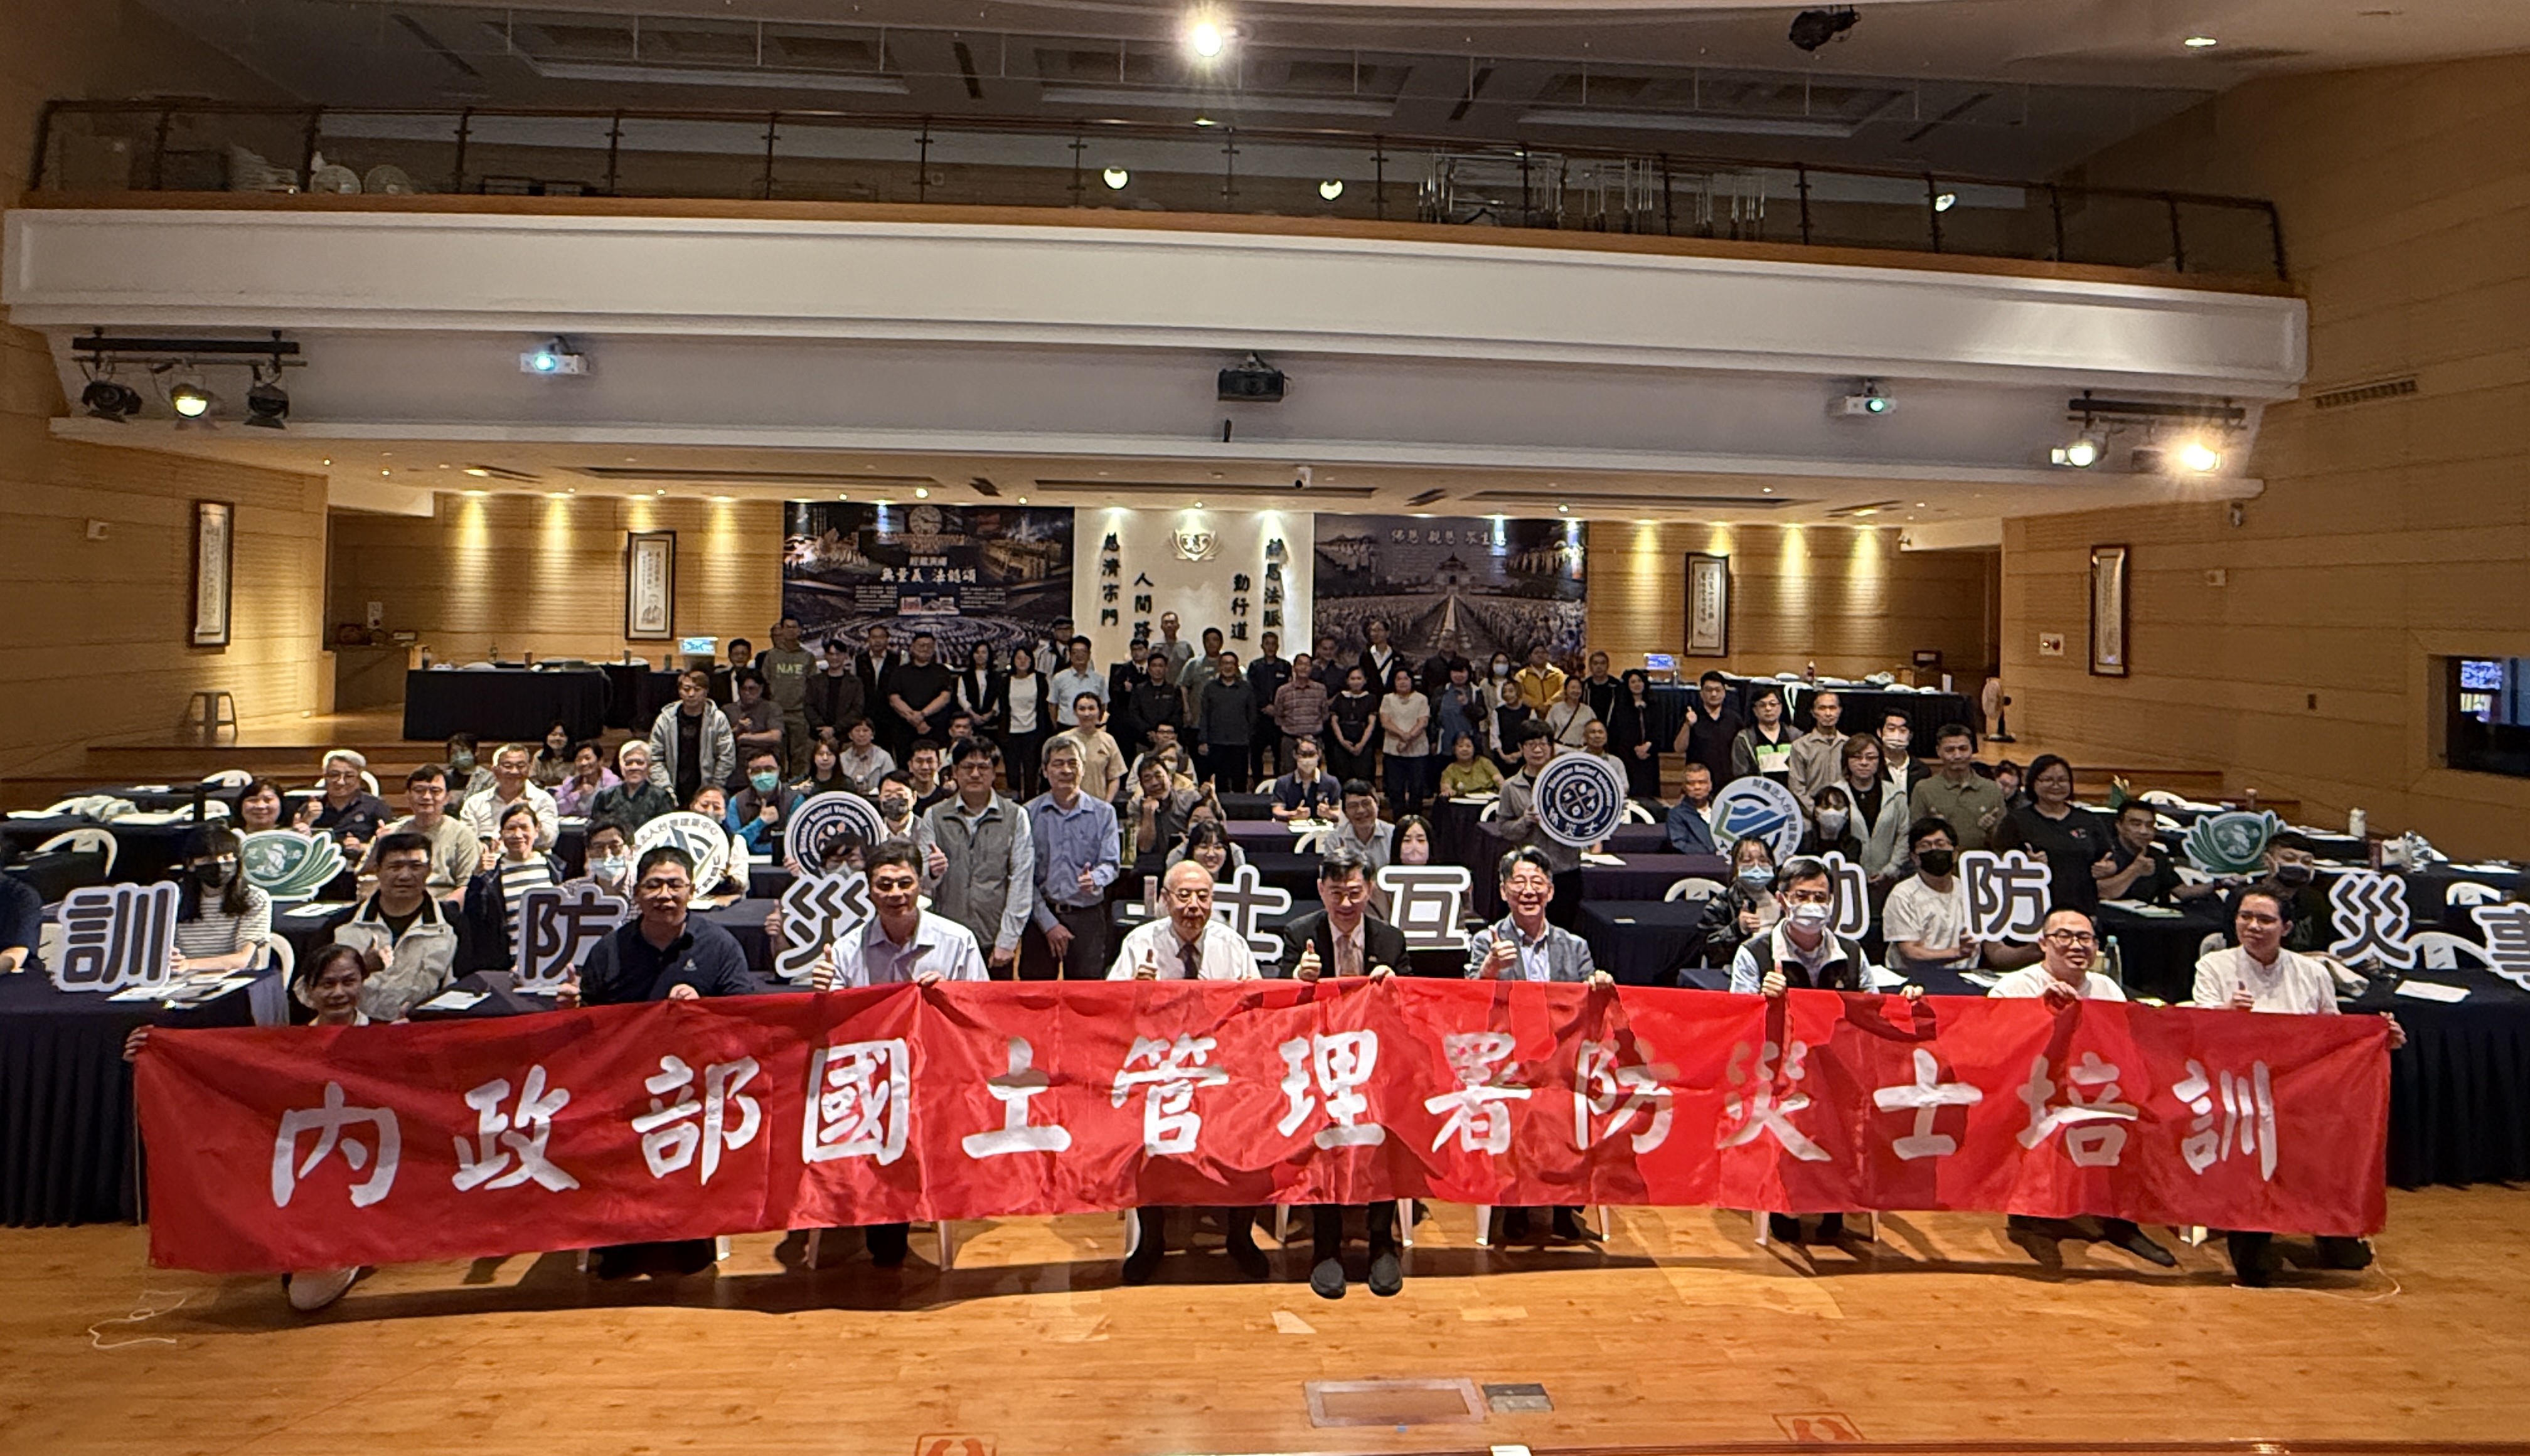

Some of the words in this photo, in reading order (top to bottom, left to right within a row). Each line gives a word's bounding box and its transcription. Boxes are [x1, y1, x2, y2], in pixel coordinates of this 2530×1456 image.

[64, 888, 168, 984] 訓
[525, 890, 620, 979] 防
[1384, 873, 1466, 948] 互
[1966, 856, 2044, 935] 防
[2334, 879, 2411, 962] 災
[270, 1028, 2278, 1208] 內政部國土管理署防災士培訓
